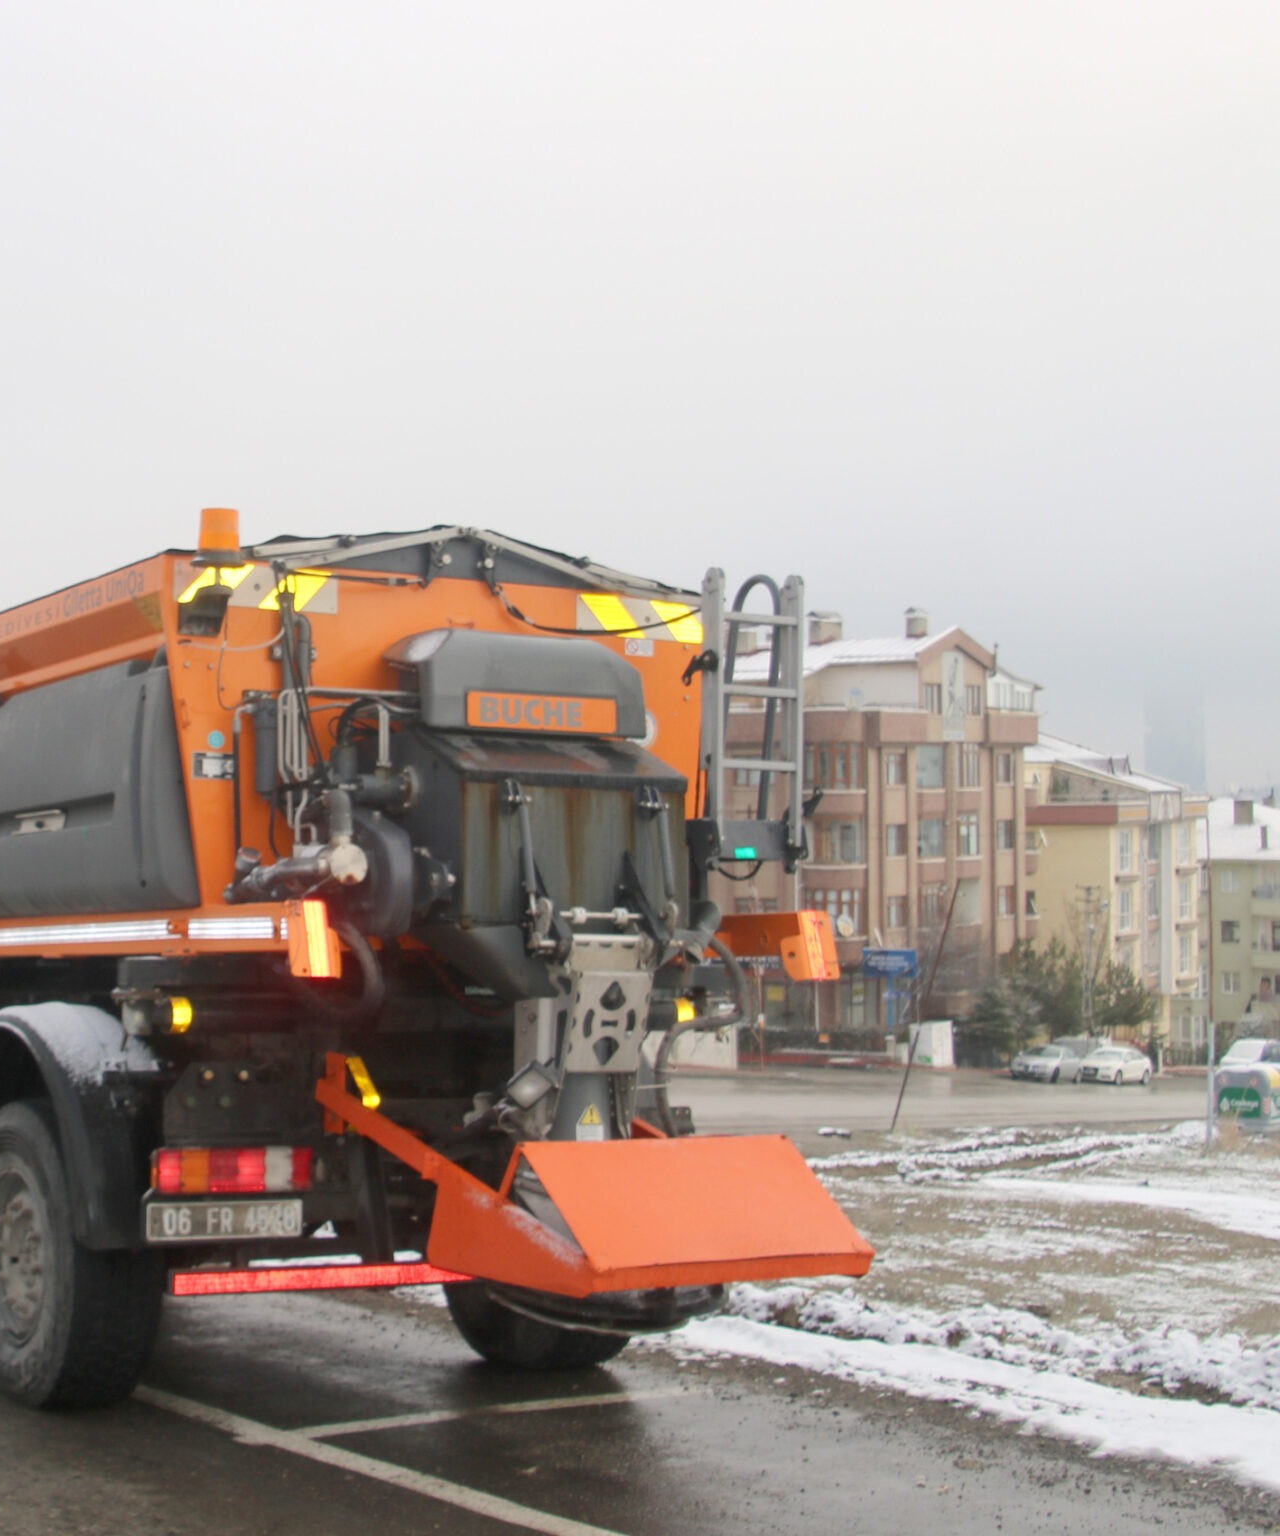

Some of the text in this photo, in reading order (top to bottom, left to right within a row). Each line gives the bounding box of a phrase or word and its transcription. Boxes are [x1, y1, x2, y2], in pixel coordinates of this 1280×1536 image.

[479, 696, 584, 728] BUCHE
[162, 1207, 192, 1236] 06
[206, 1206, 233, 1234] FR
